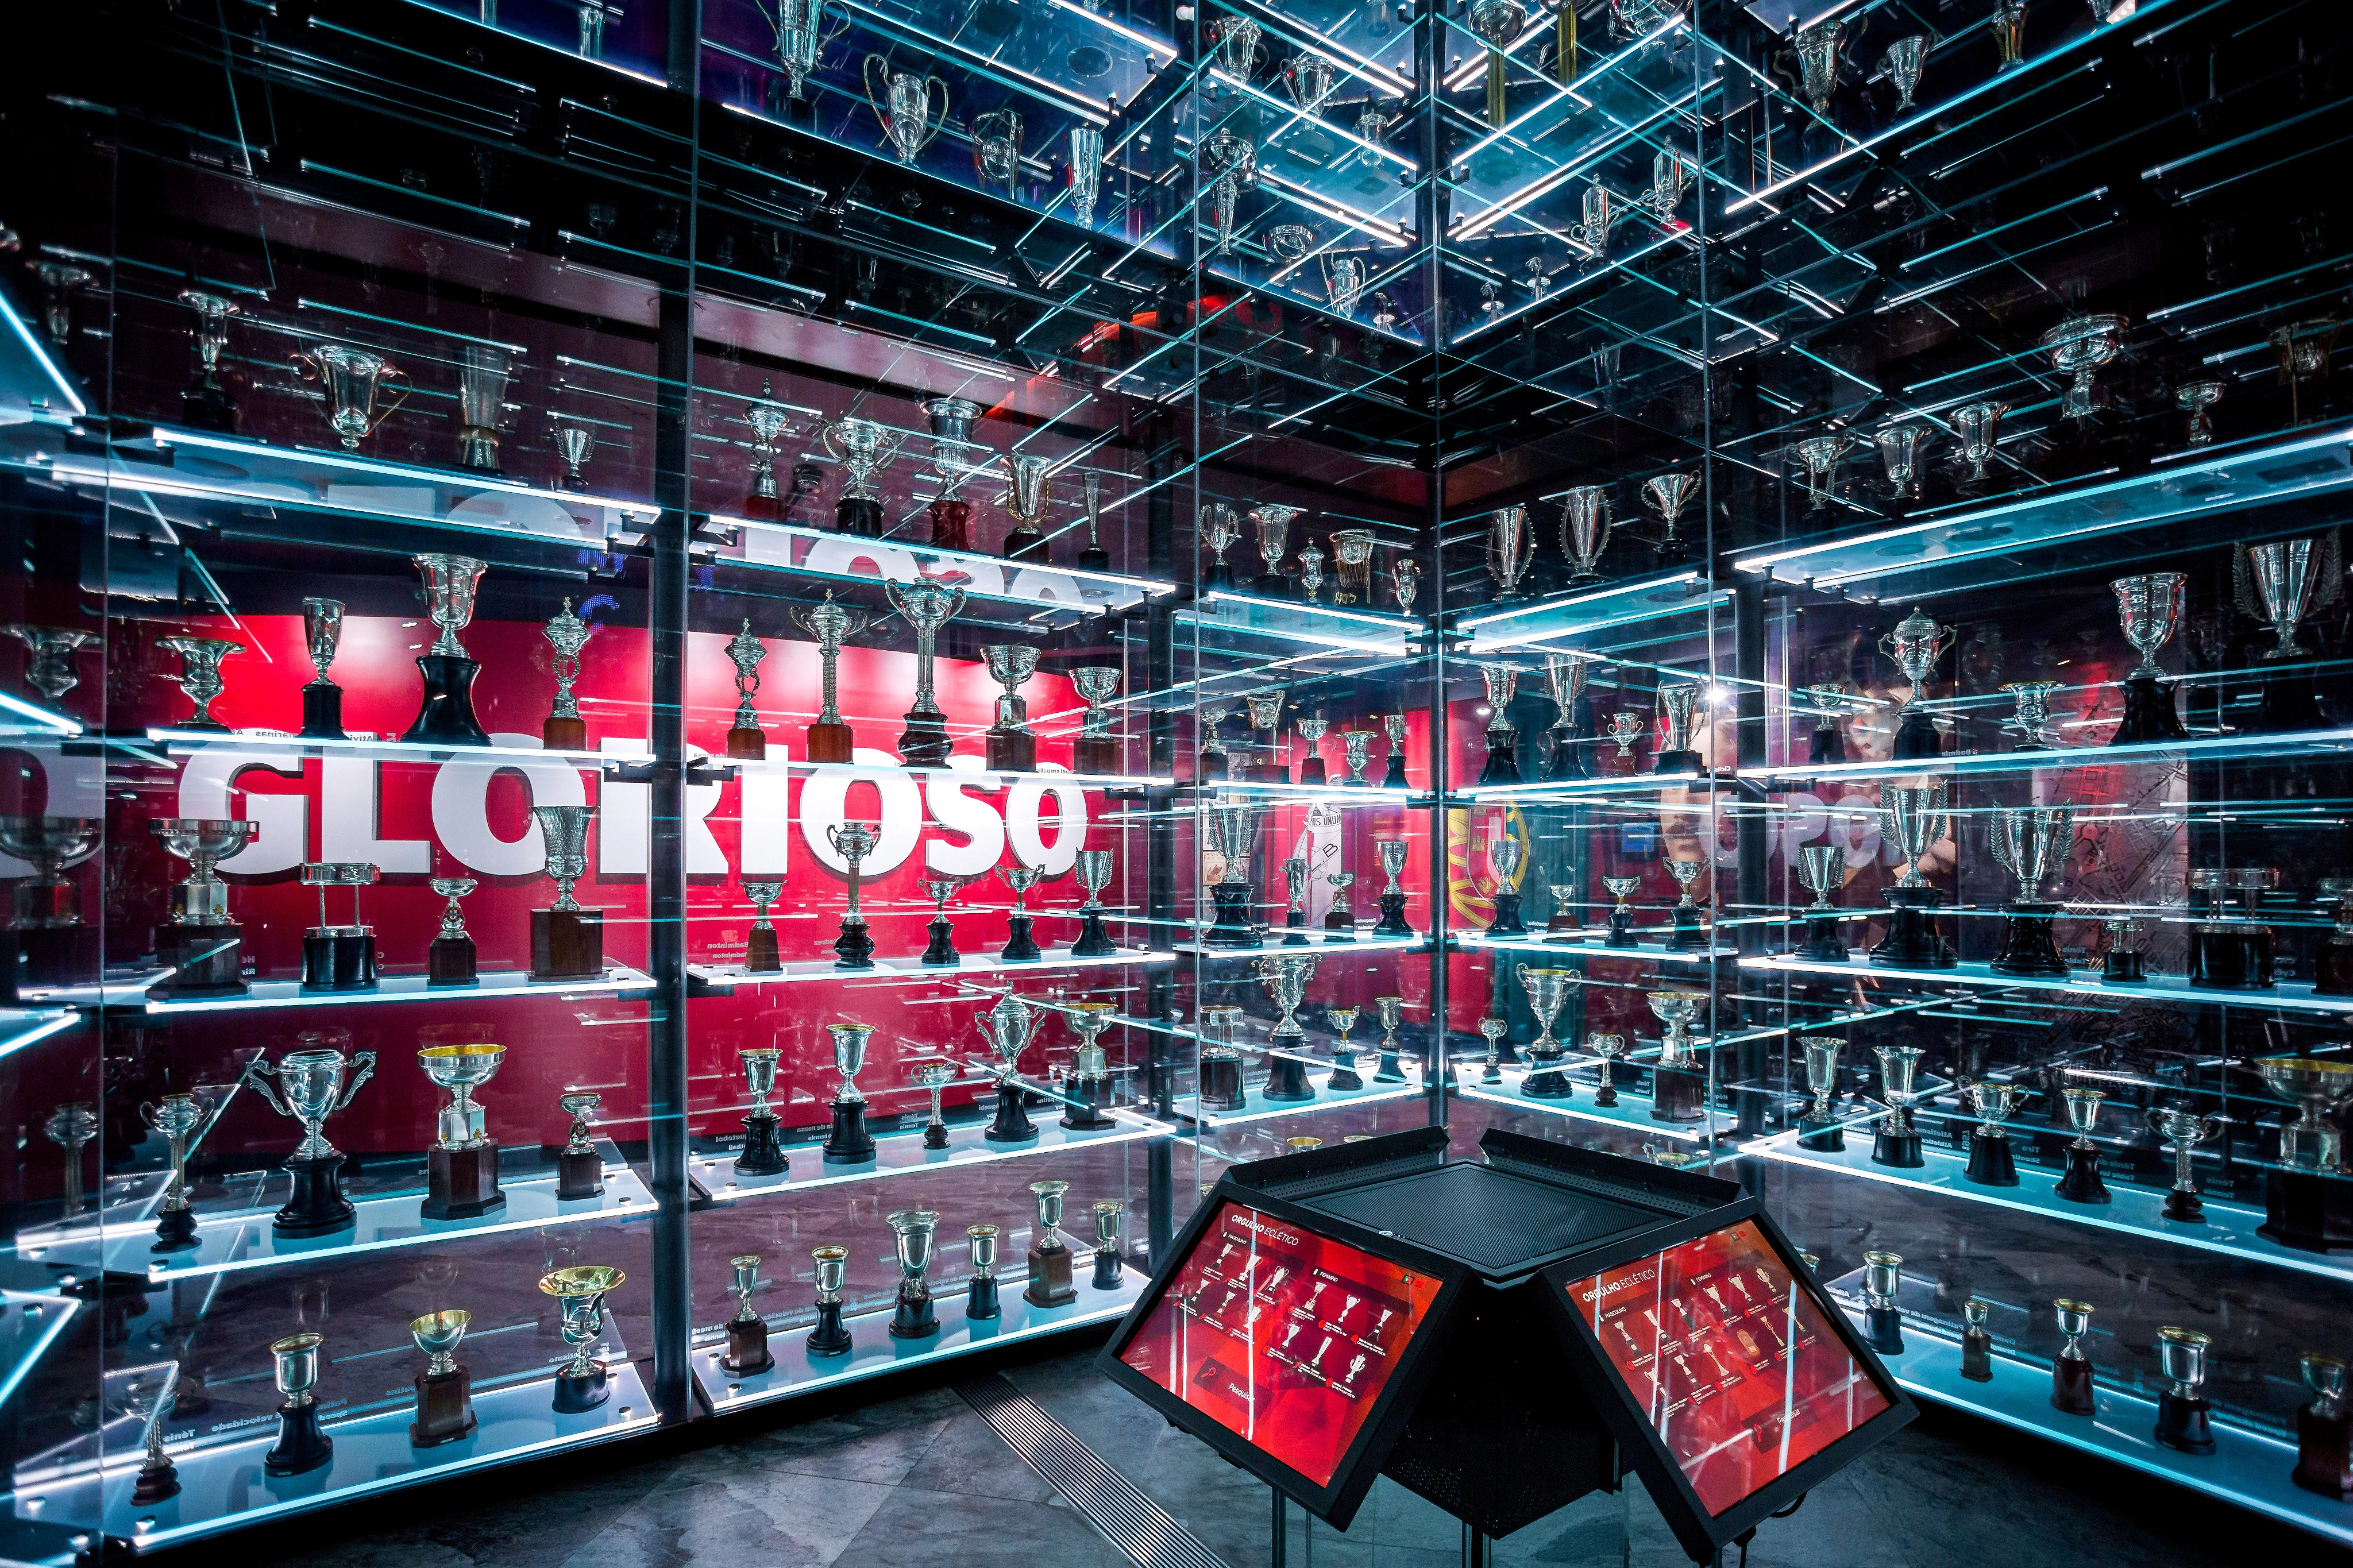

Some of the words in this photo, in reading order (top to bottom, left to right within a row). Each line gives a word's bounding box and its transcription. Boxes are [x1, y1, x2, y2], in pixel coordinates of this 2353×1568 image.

[178, 727, 1088, 878] GLORIOSO
[1230, 1214, 1264, 1233] ORGULHO
[1264, 1226, 1299, 1246] ECLÉTICO
[1319, 1270, 1338, 1283] FEMININO
[1582, 1281, 1622, 1303] ORGULHO
[1619, 1268, 1656, 1289] ECLÉTICO
[1604, 1306, 1626, 1319] MASCULINO
